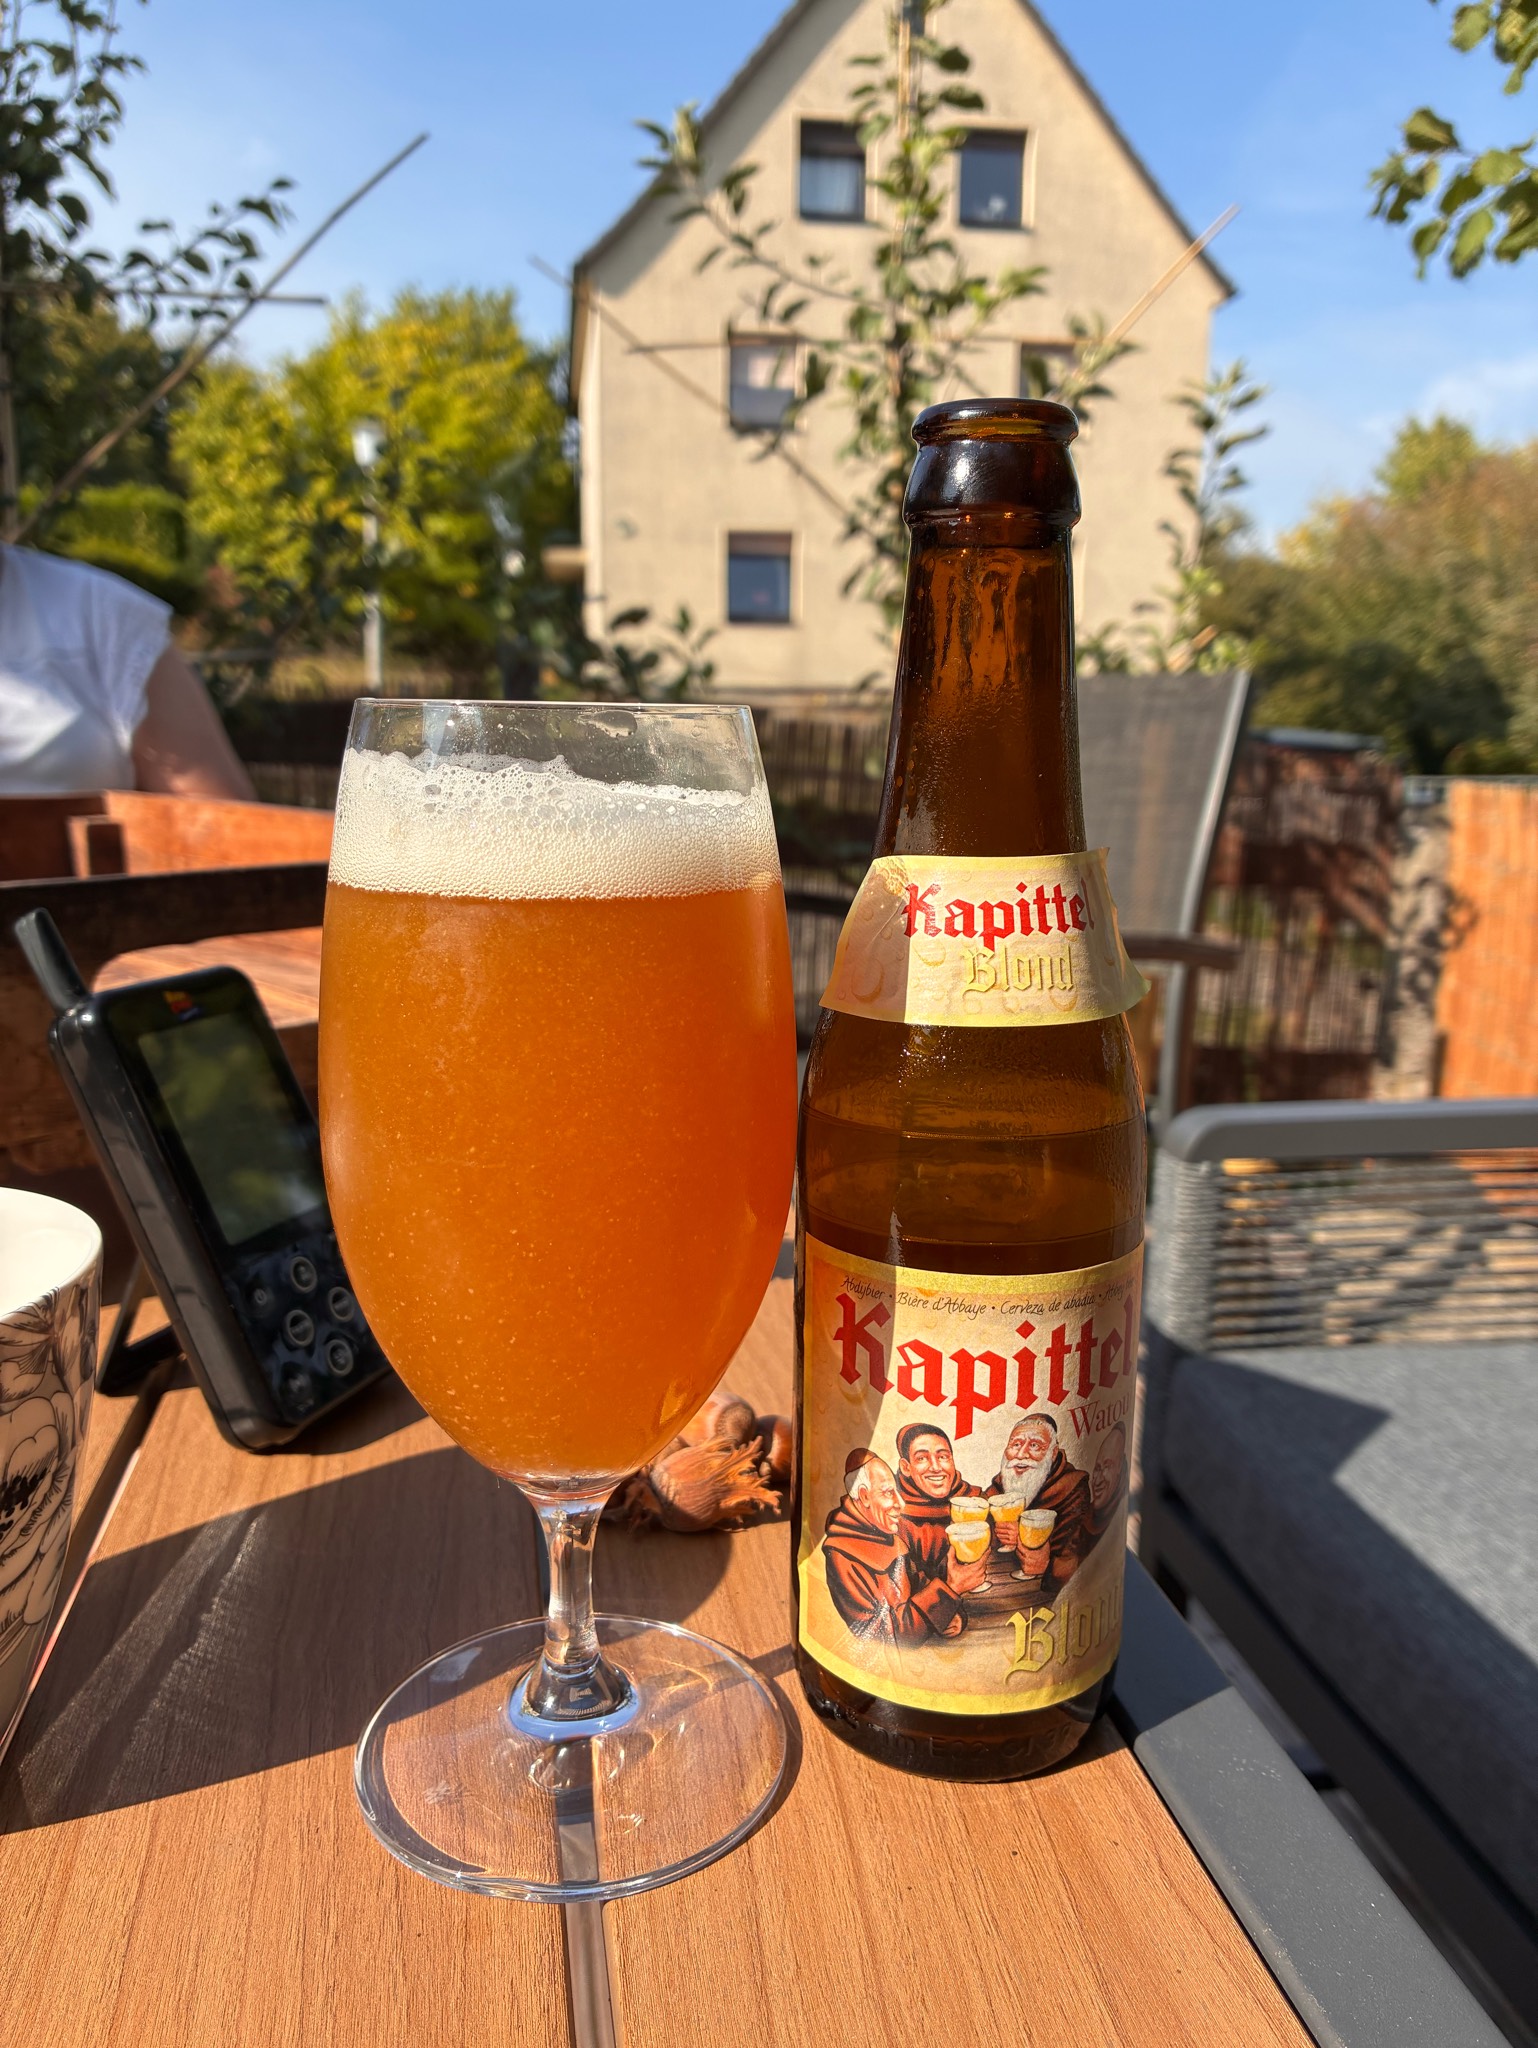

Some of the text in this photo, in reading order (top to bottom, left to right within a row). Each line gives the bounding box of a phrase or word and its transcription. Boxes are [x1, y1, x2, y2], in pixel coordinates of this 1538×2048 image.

[901, 881, 1095, 951] Kapittel
[961, 945, 1075, 996] Blond
[896, 1292, 929, 1309] Bière
[932, 1295, 987, 1320] d'Abbaye
[1000, 1299, 1046, 1316] Cerveza
[1049, 1297, 1062, 1312] de
[832, 1292, 1135, 1441] Kapittel
[1067, 1391, 1131, 1440] Watou
